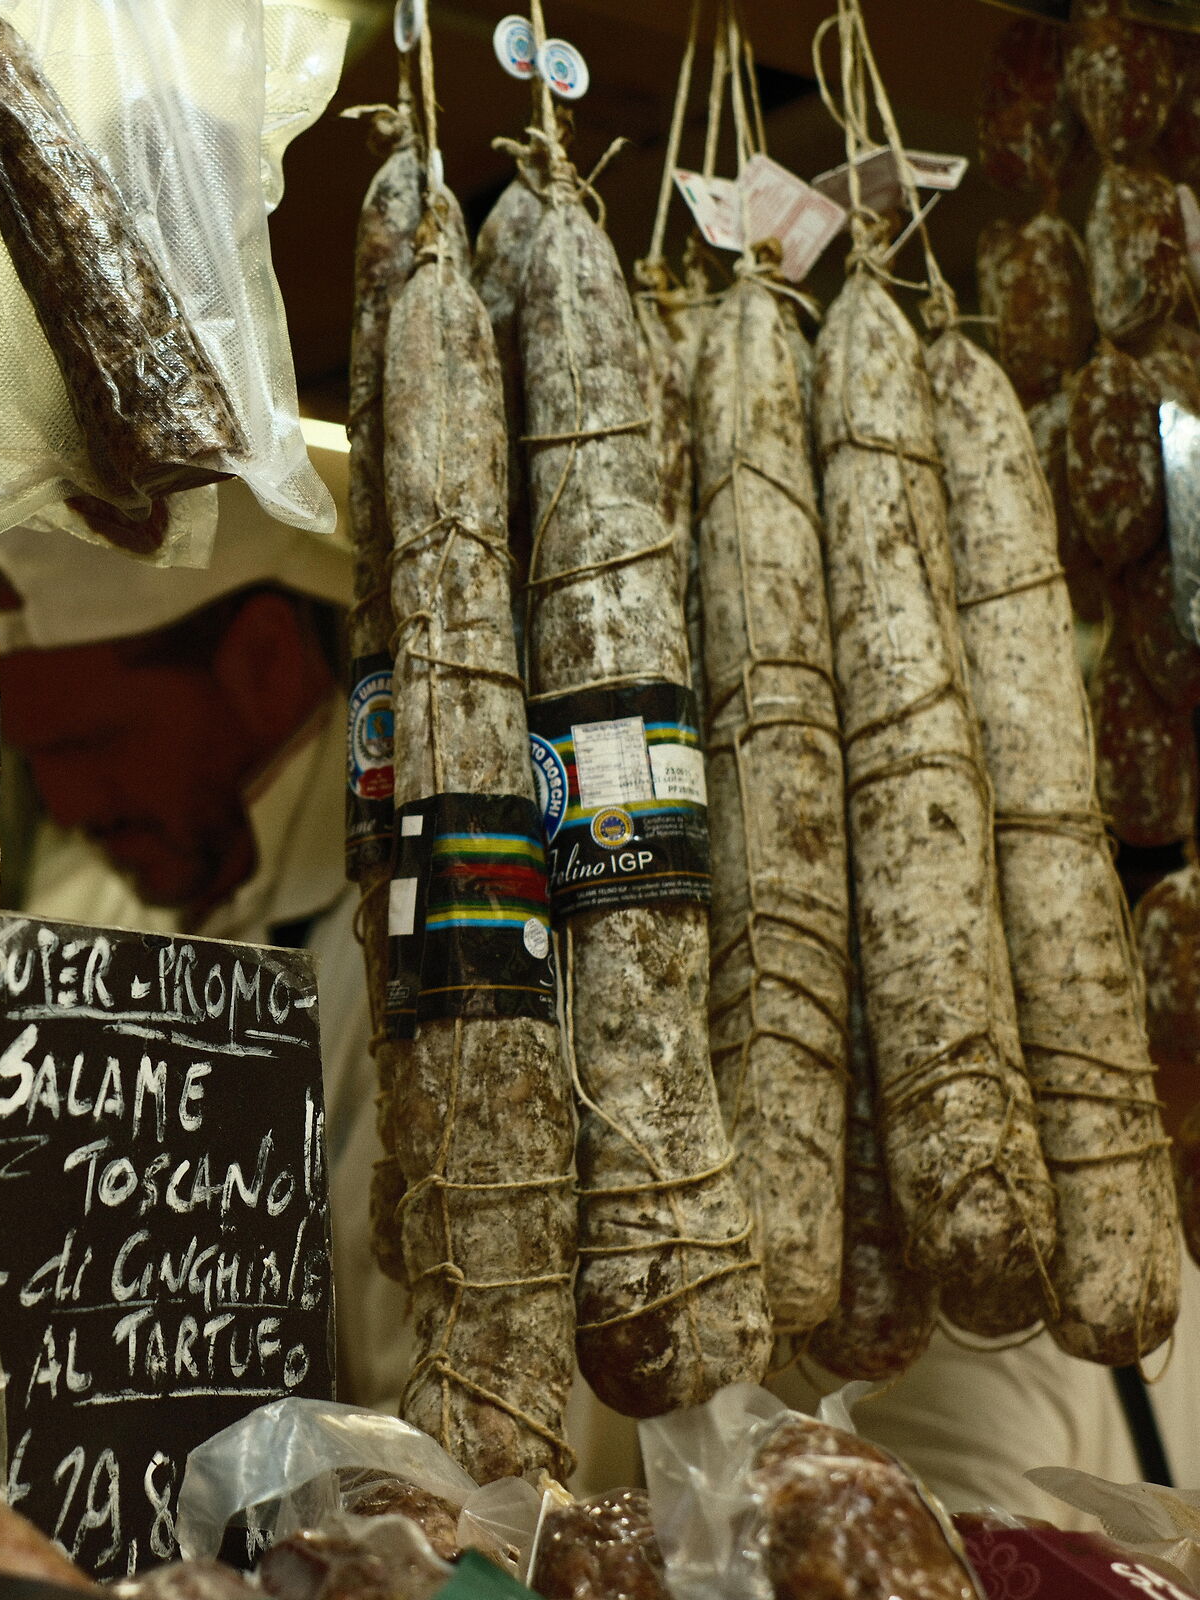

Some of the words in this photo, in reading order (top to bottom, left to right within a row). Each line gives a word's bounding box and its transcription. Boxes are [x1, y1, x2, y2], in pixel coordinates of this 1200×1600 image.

[542, 756, 563, 818] BOSCHI
[610, 851, 653, 873] IGP
[25, 1325, 92, 1408] AL
[112, 1307, 310, 1389] TARTUFO
